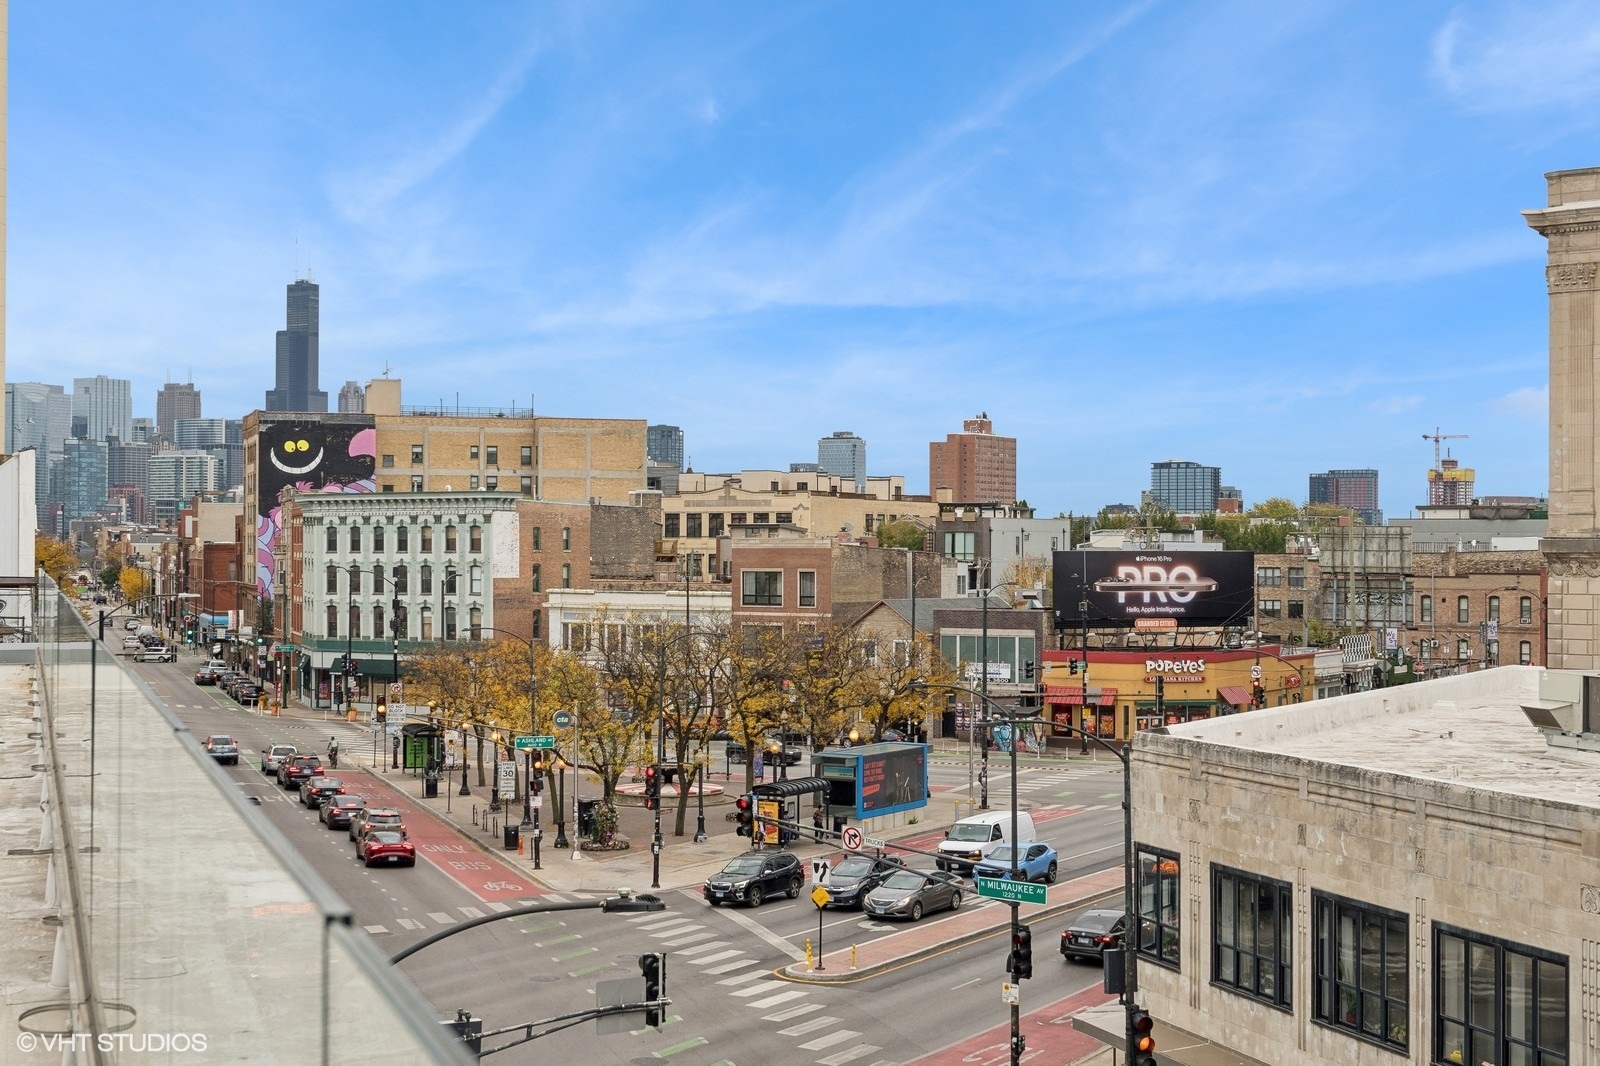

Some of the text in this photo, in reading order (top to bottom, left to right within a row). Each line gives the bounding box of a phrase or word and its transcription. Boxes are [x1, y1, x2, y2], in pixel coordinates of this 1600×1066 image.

[1118, 566, 1197, 603] PRO
[865, 838, 883, 846] TRUCKS
[422, 844, 468, 854] ONLY
[448, 861, 492, 871] BUS
[987, 880, 1034, 894] MILWAUKEE
